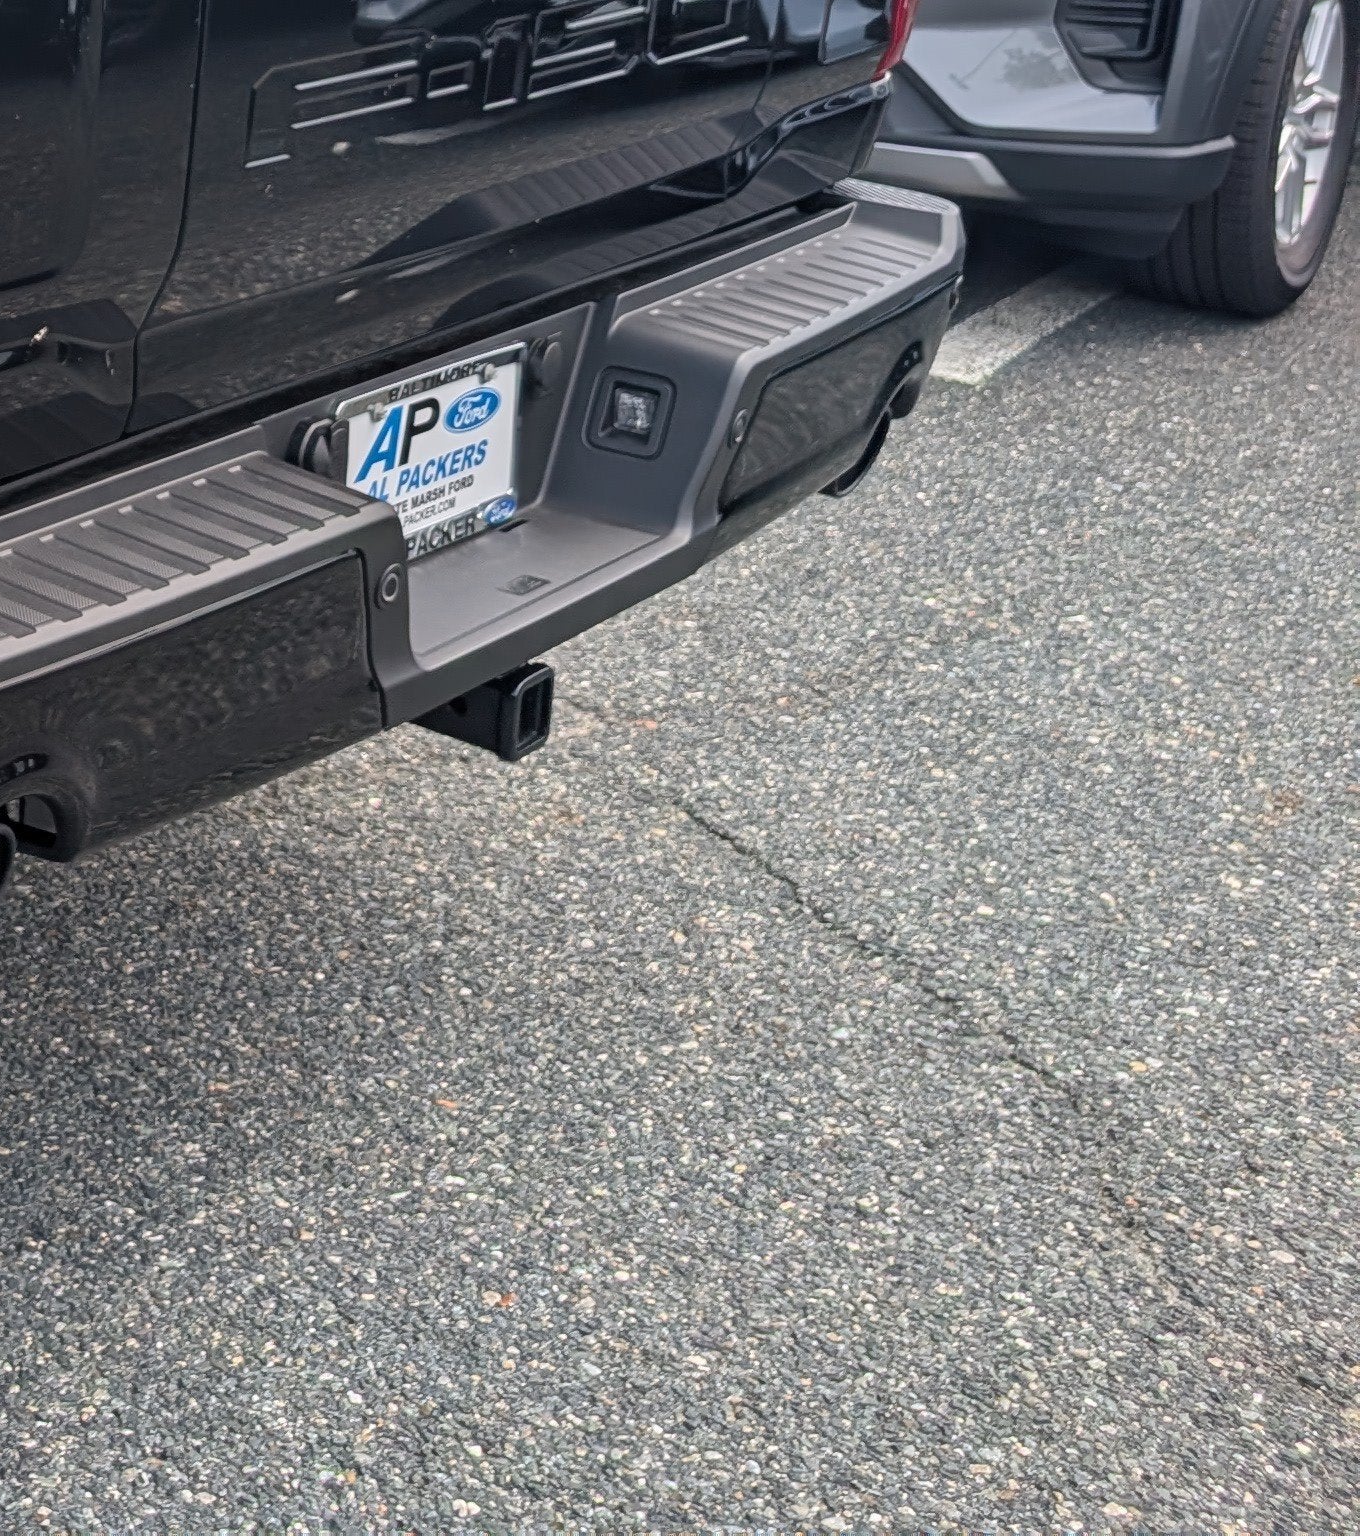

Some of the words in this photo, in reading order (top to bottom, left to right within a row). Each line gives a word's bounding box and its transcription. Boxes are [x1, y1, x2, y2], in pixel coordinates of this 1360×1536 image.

[354, 397, 440, 484] AP
[368, 477, 389, 502] AL
[396, 438, 489, 496] PACKERS
[411, 484, 446, 509] MARSH
[448, 474, 475, 495] FORD
